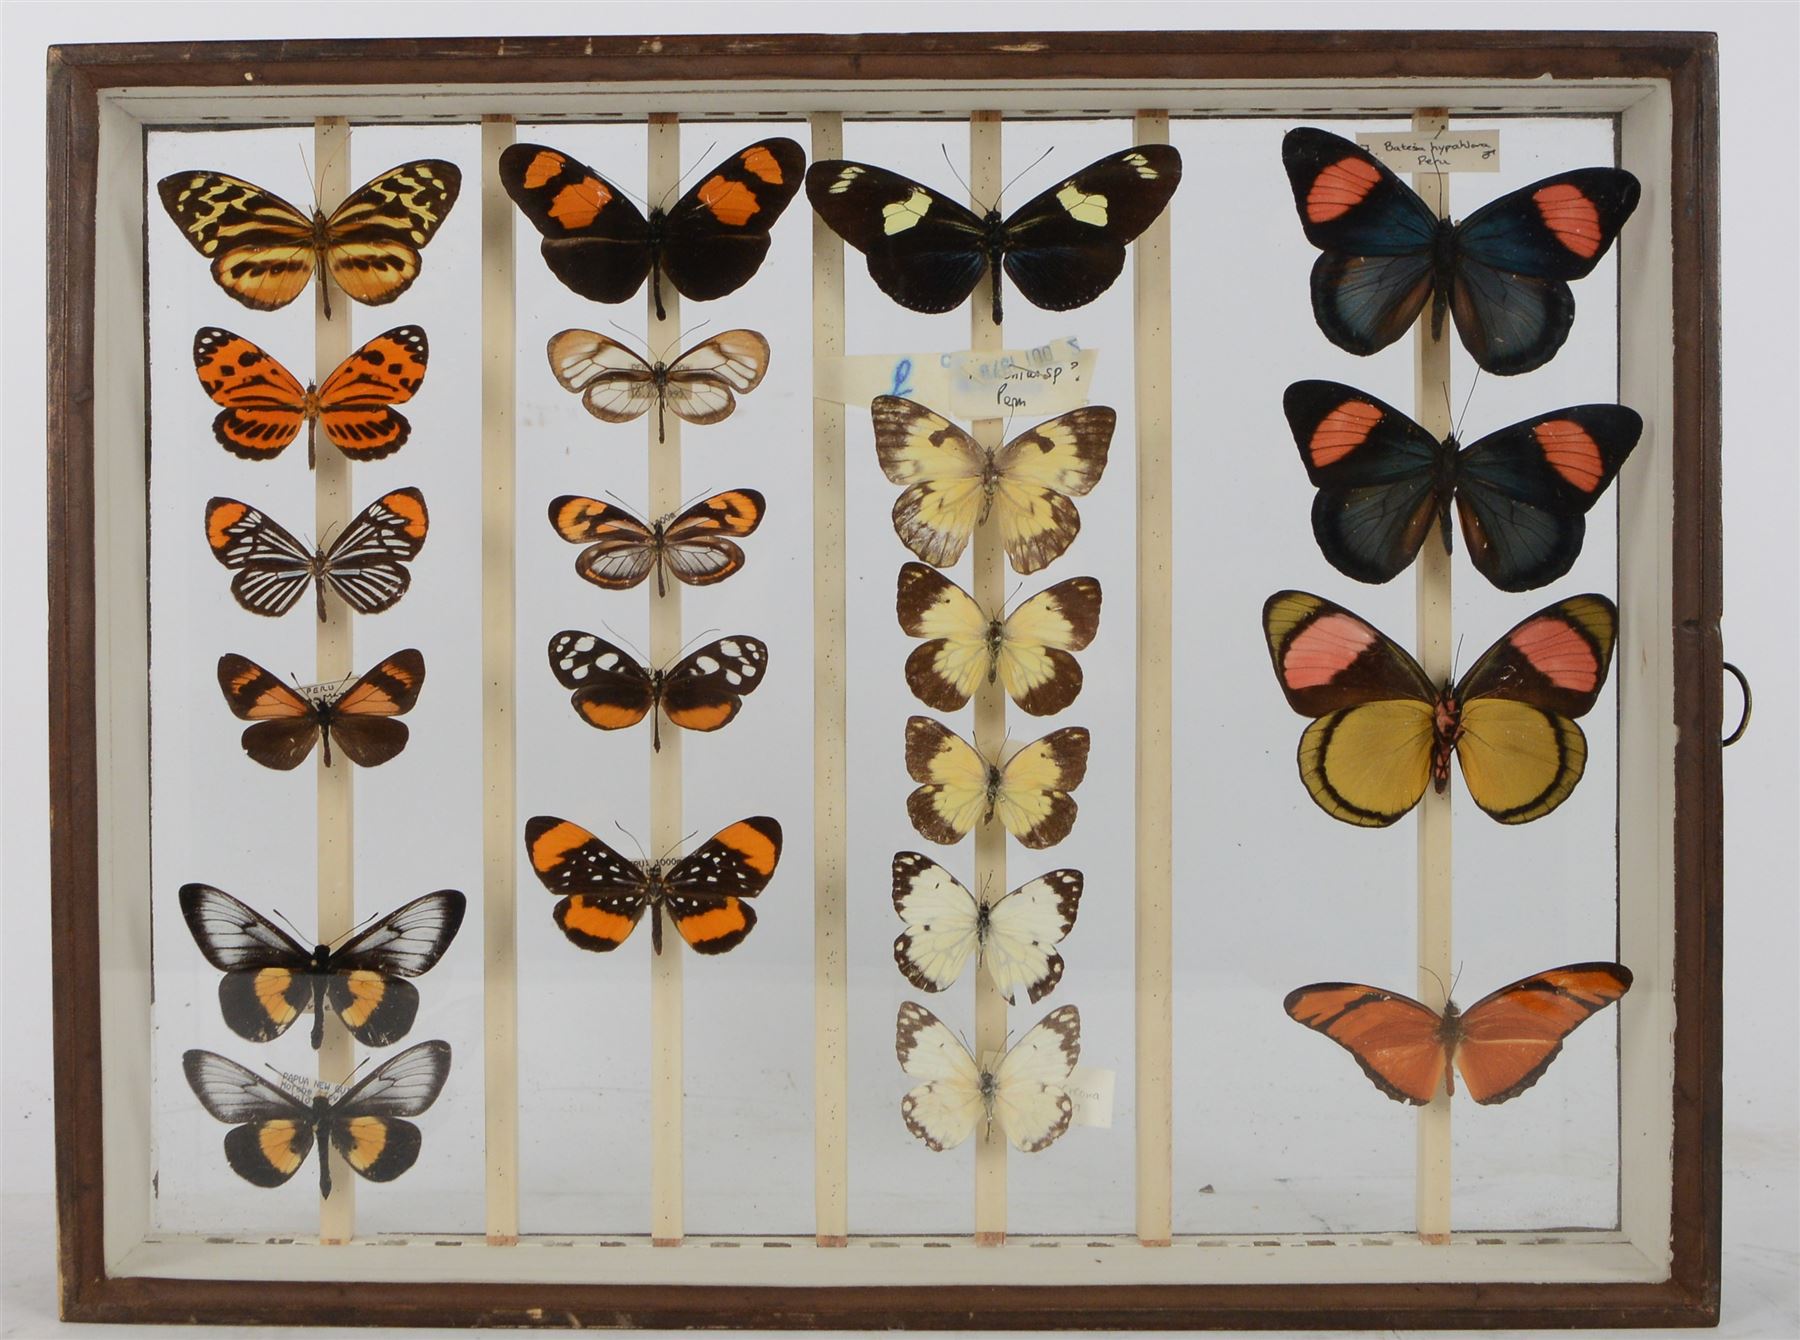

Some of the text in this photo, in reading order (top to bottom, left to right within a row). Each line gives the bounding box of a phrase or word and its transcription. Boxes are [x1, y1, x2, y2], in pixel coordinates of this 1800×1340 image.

[306, 684, 334, 694] PERU
[282, 1072, 309, 1087] PAPUA
[314, 1080, 330, 1091] NEW
